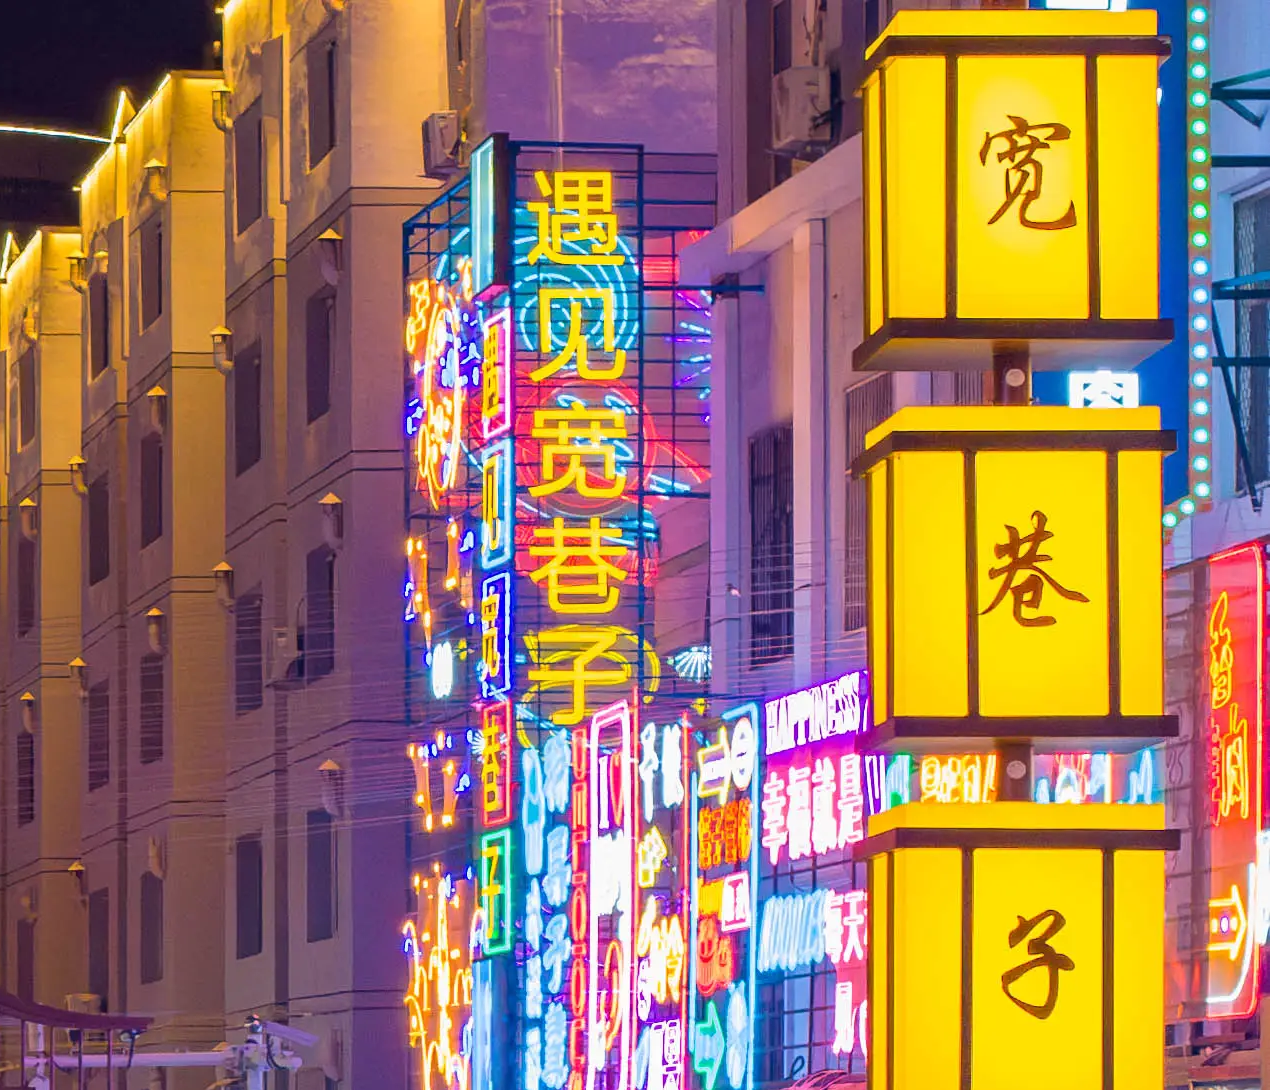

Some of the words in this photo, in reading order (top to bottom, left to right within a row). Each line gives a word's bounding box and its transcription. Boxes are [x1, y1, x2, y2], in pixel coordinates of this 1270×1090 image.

[979, 114, 1078, 231] 宽
[527, 170, 627, 727] 遇见宽巷子
[977, 509, 1091, 628] 巷
[1001, 908, 1076, 1021] 子
